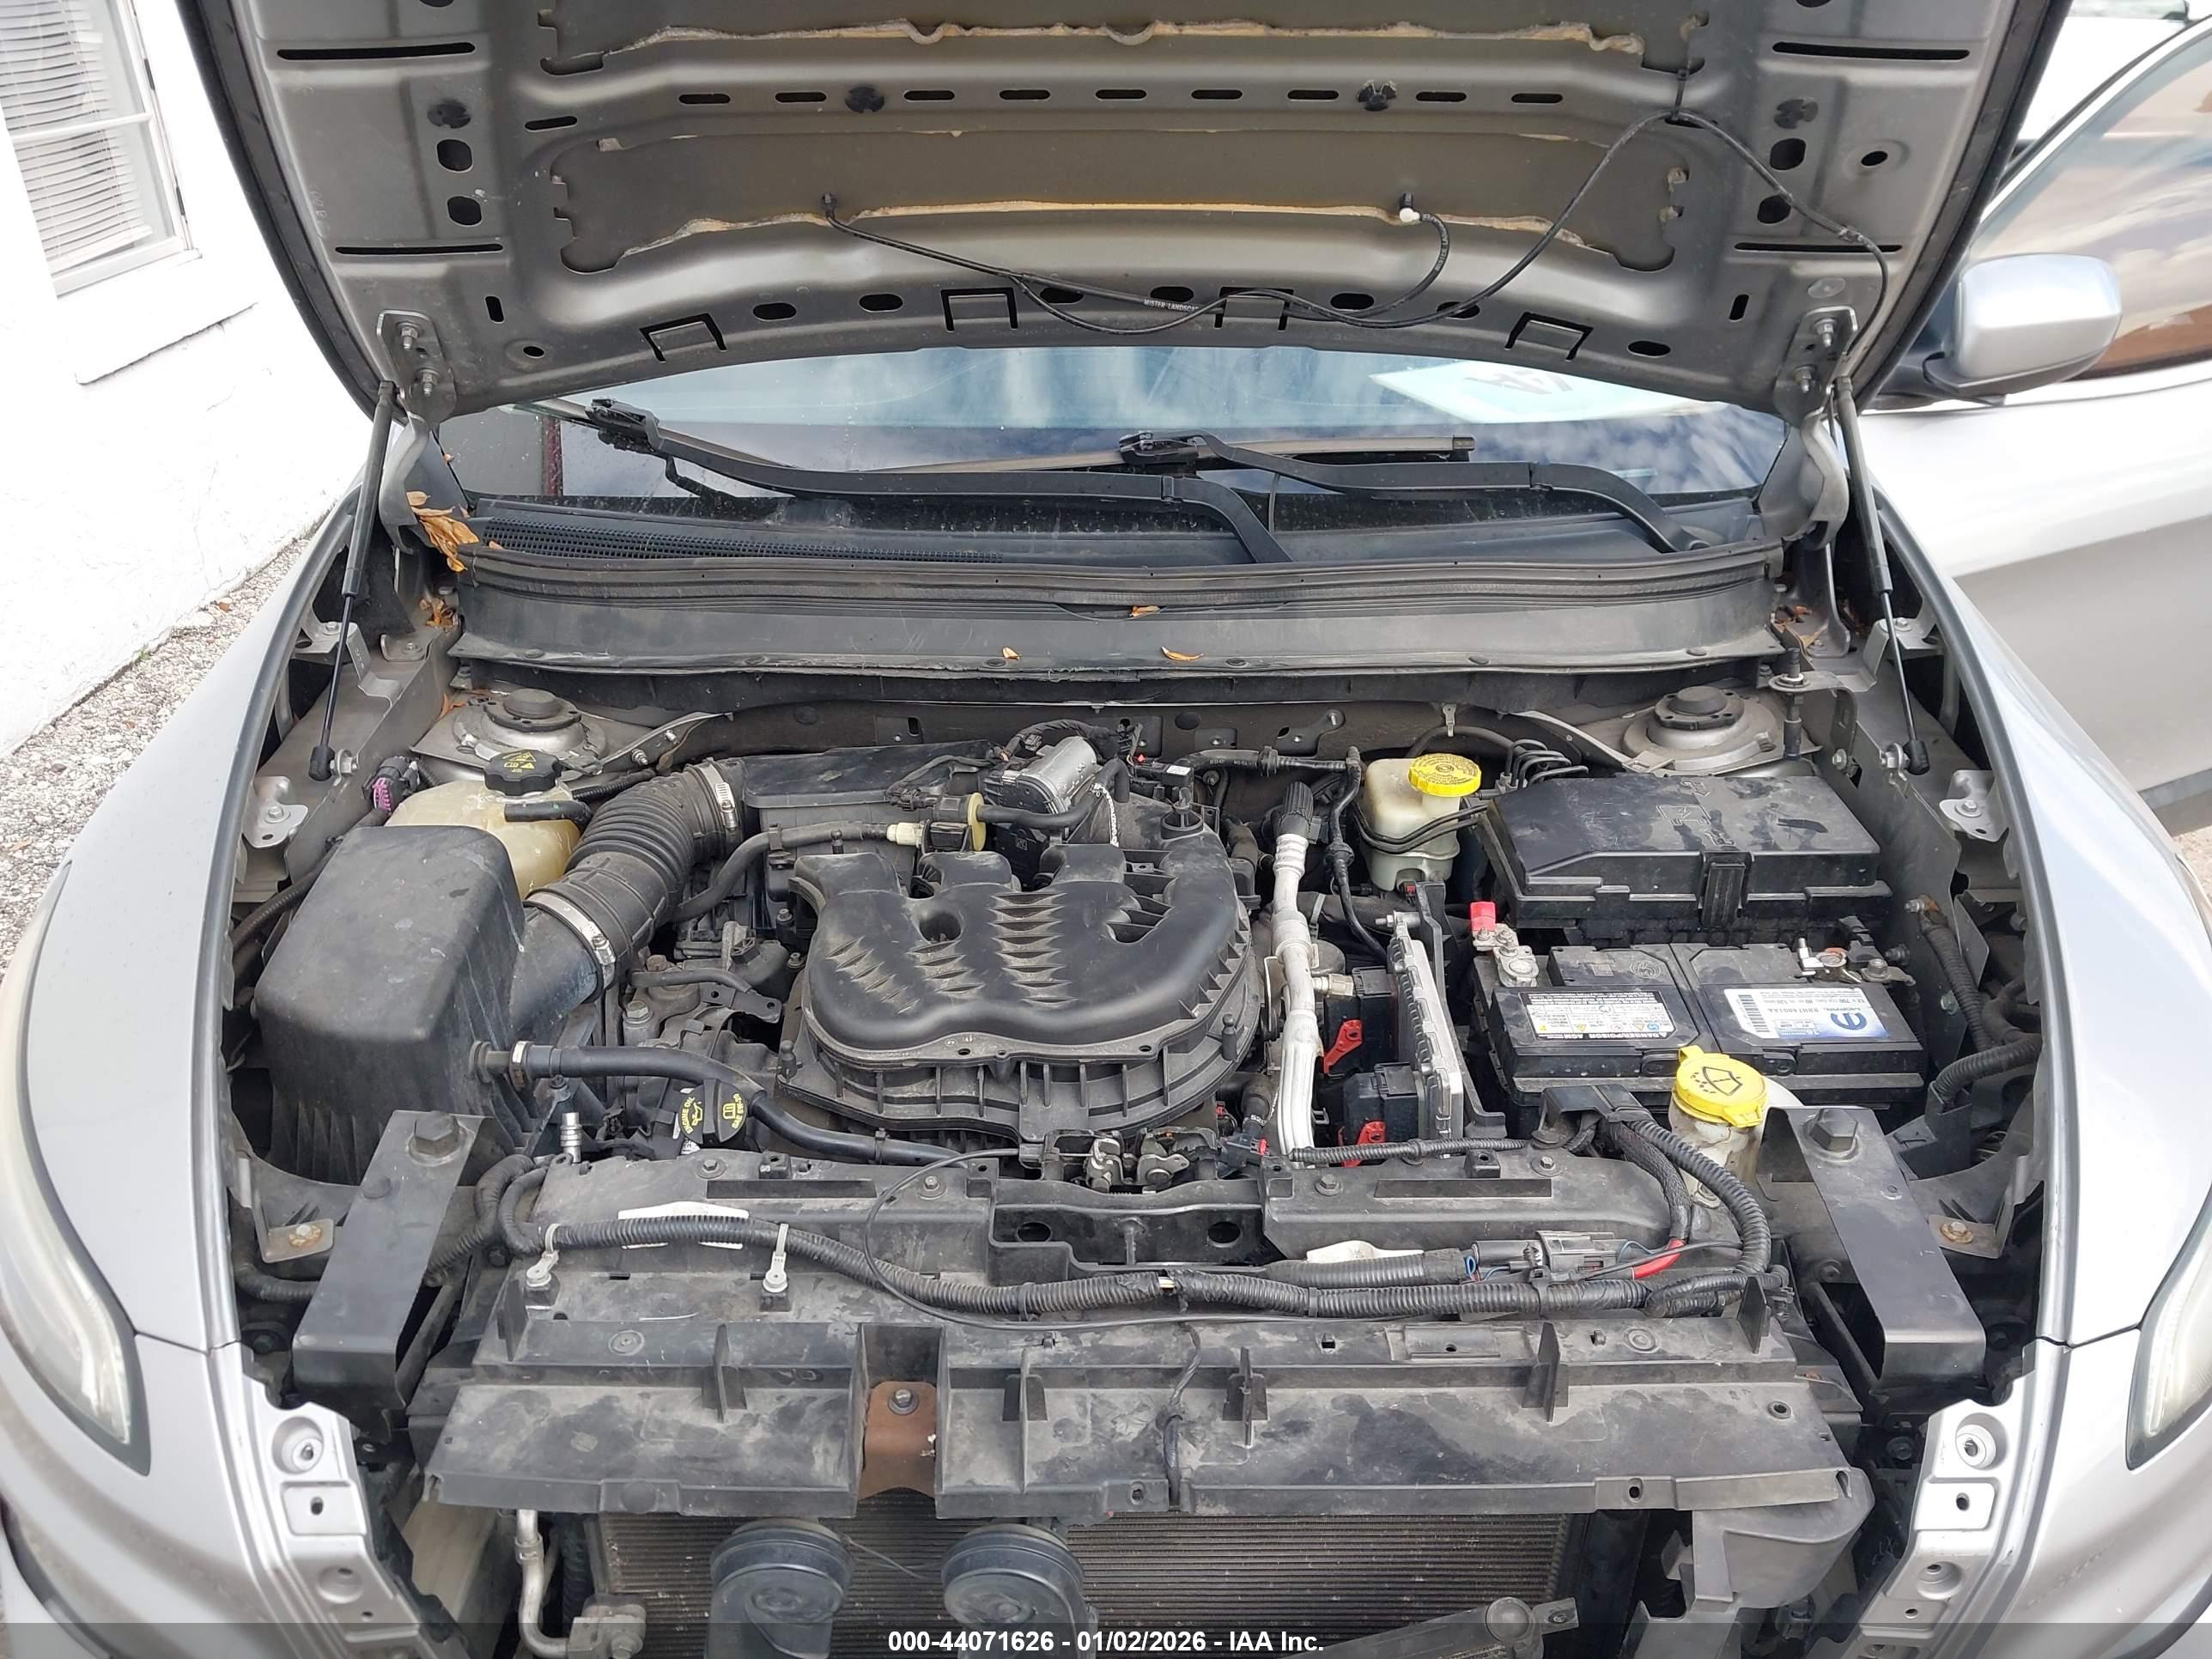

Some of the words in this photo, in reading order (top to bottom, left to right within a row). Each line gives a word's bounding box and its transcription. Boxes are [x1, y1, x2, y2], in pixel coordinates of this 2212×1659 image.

[1143, 298, 1166, 309] MISTER
[684, 1097, 696, 1108] OIL
[681, 1109, 694, 1133] ENGINE
